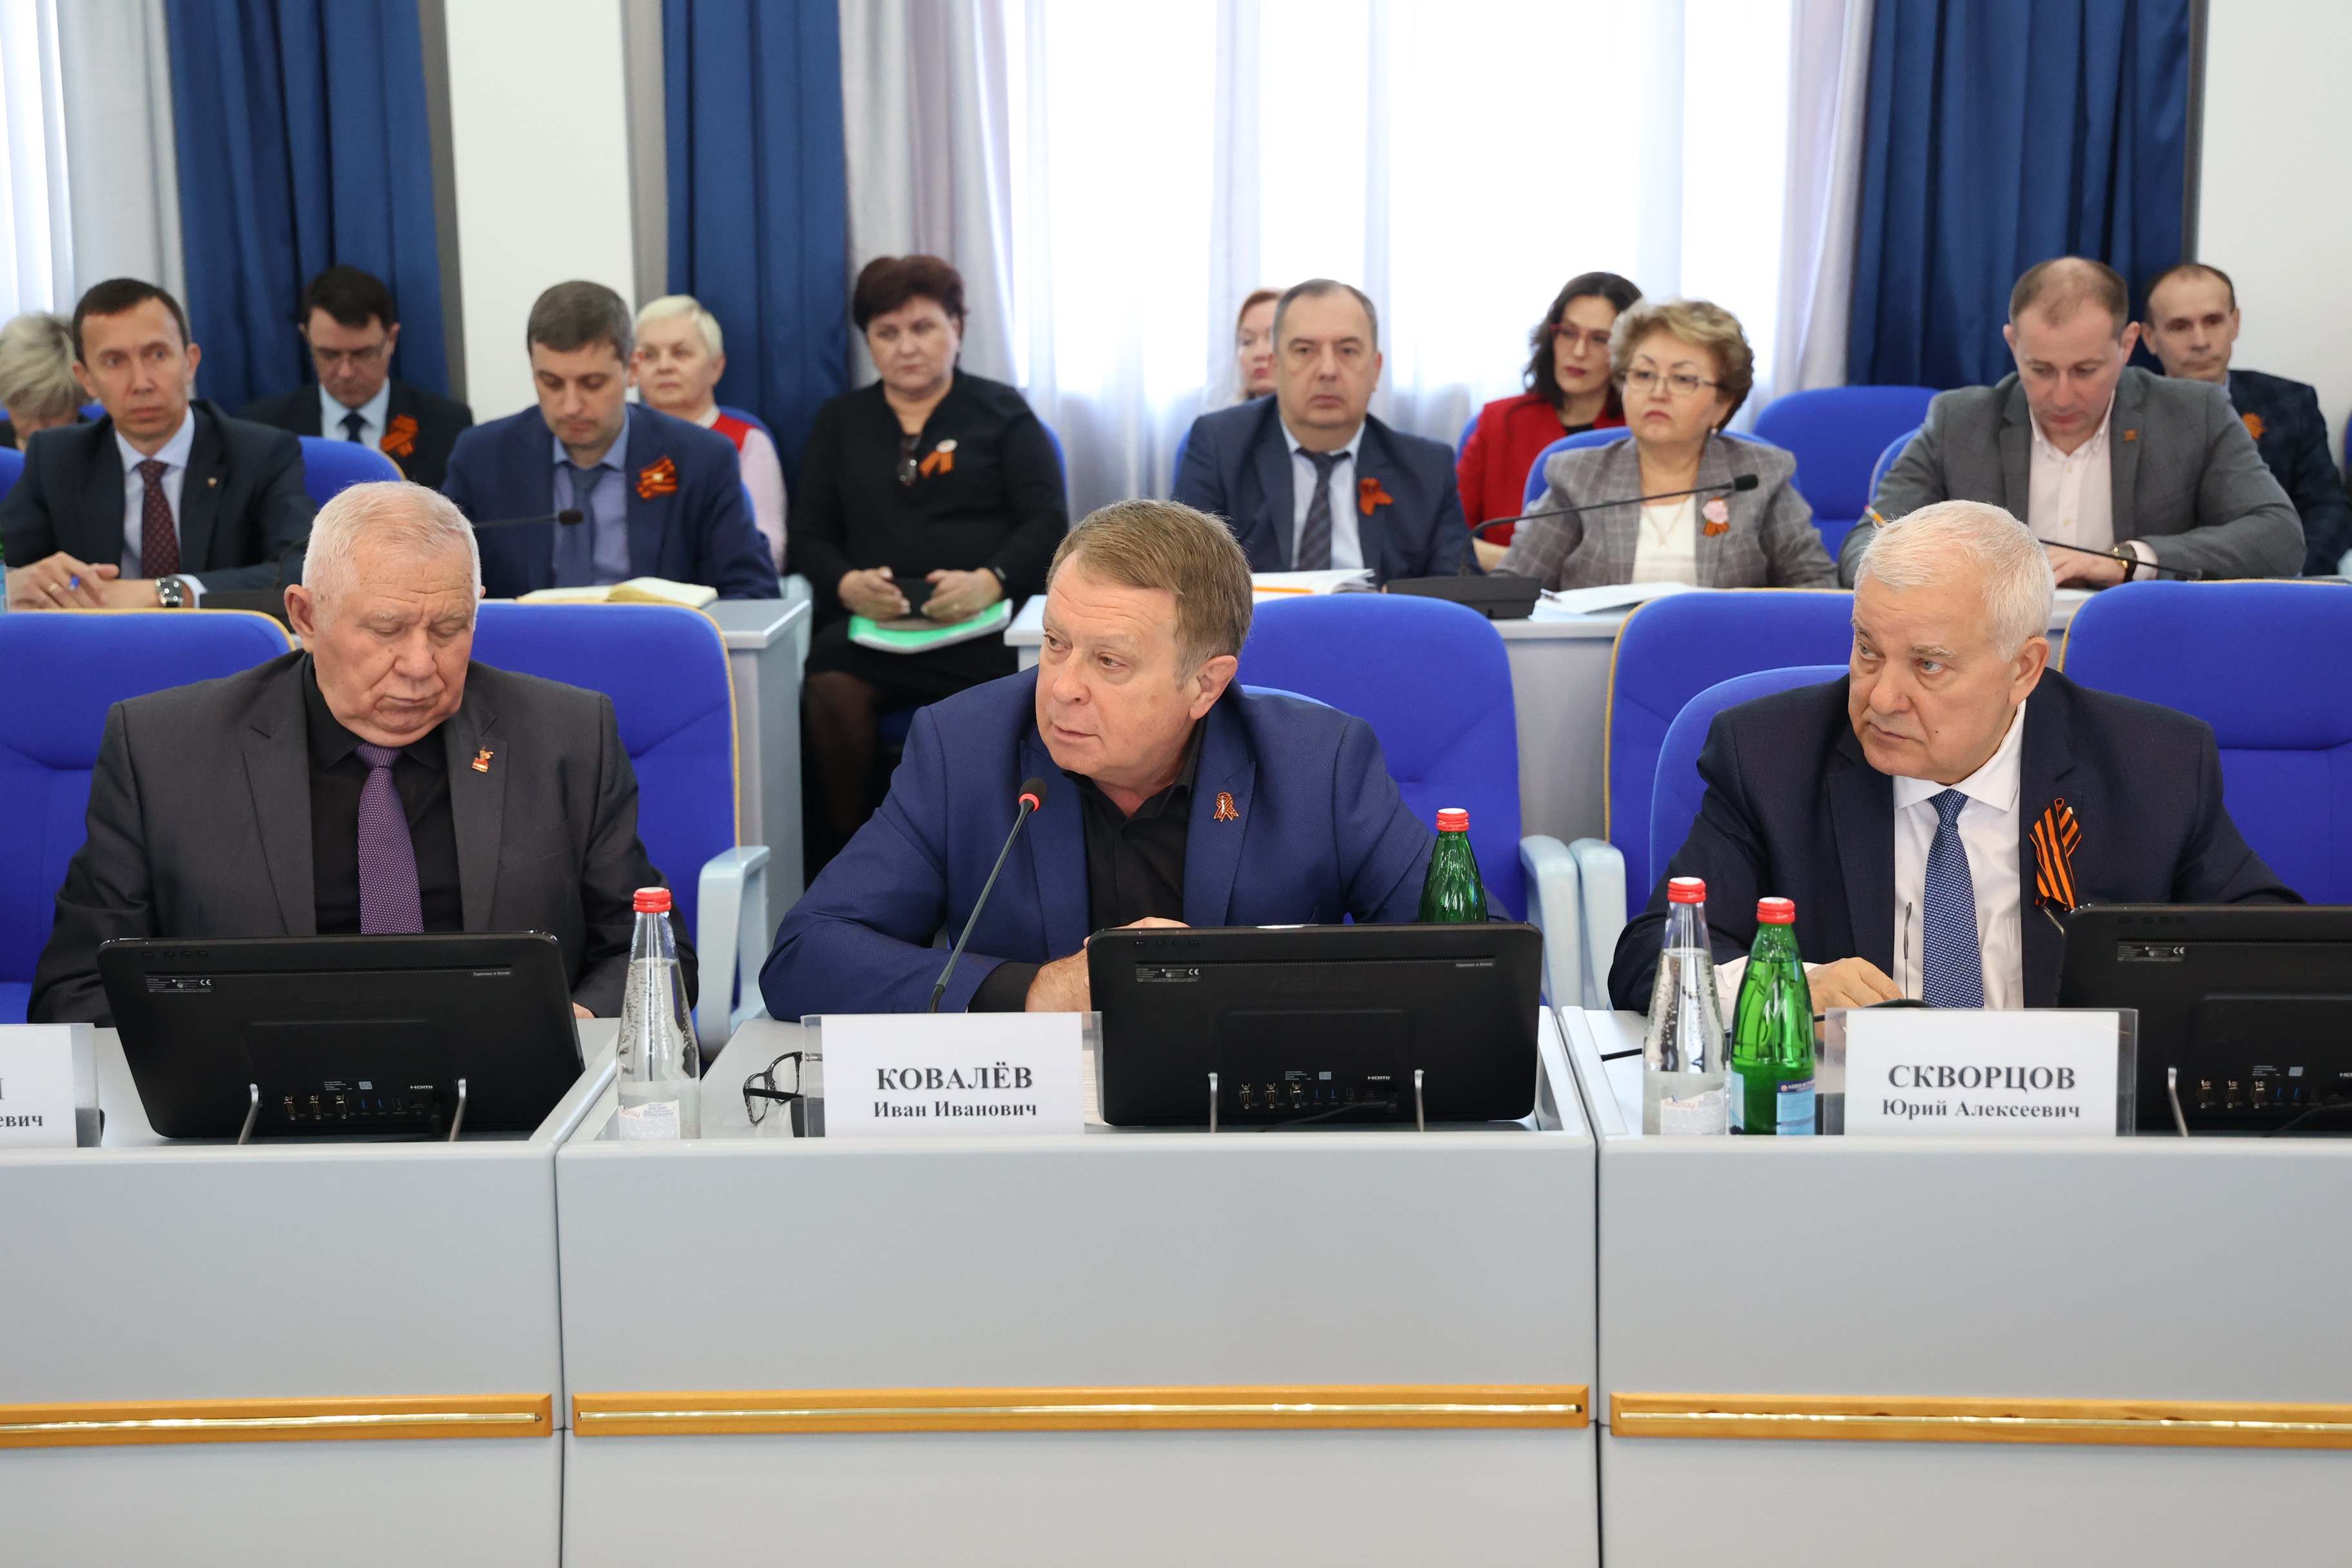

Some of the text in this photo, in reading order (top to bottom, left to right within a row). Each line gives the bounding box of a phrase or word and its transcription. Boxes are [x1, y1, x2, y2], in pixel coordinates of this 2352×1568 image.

[877, 1061, 1033, 1090] КОВАЛЁВ
[1888, 1064, 2075, 1093] СКВОРЦОВ
[874, 1100, 1037, 1117] Иван Иванович
[1883, 1099, 2080, 1121] Юрий Алексеевич
